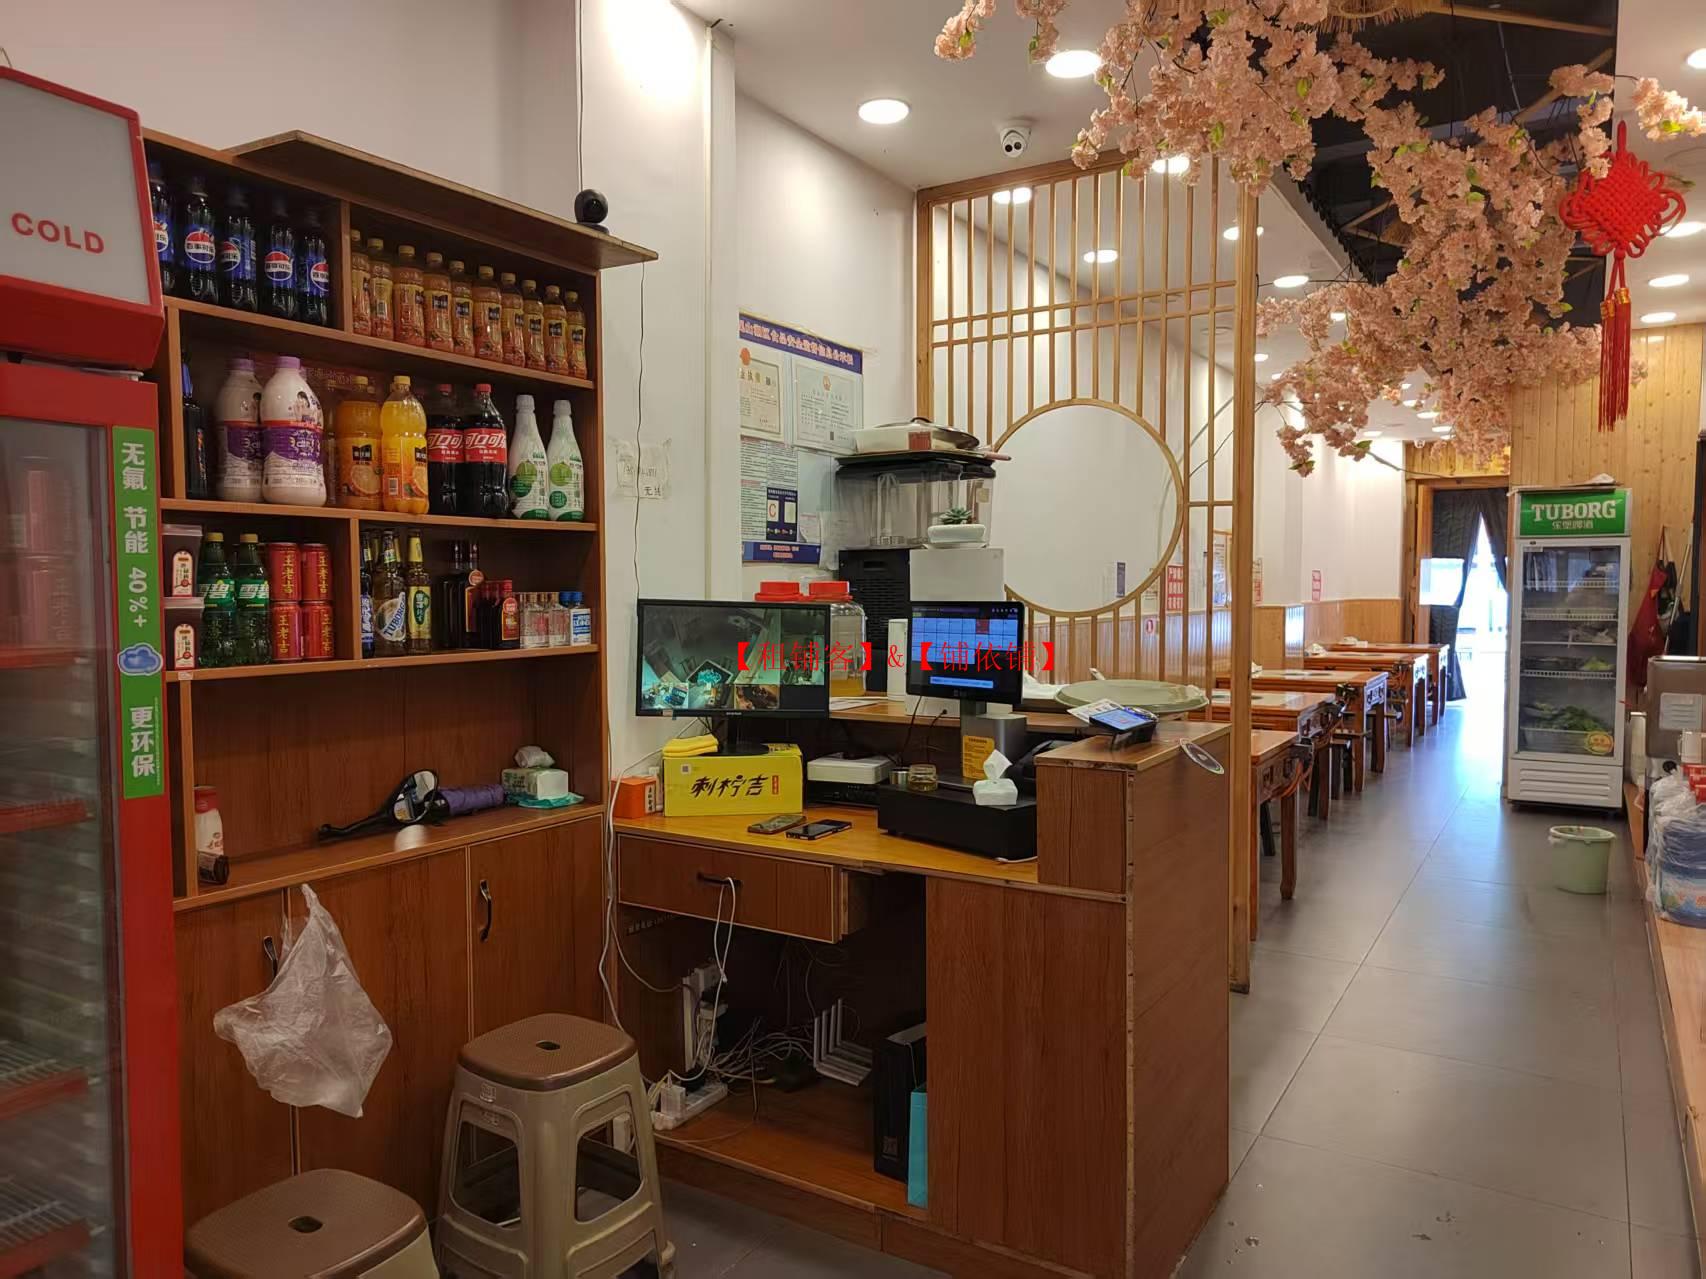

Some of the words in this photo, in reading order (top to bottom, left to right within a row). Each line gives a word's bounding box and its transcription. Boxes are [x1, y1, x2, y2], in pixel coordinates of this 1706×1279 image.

[11, 212, 104, 254] COLD
[122, 442, 147, 490] 无氟
[123, 506, 149, 554] 节能
[769, 503, 777, 518] C
[1531, 500, 1617, 522] TUBORG
[282, 551, 295, 594] 王老吉
[318, 552, 329, 594] 王老吉
[277, 614, 290, 654] 王老吉
[321, 613, 333, 652] 王老吉
[130, 706, 155, 778] 更环保
[691, 773, 769, 798] 刺柠吉
